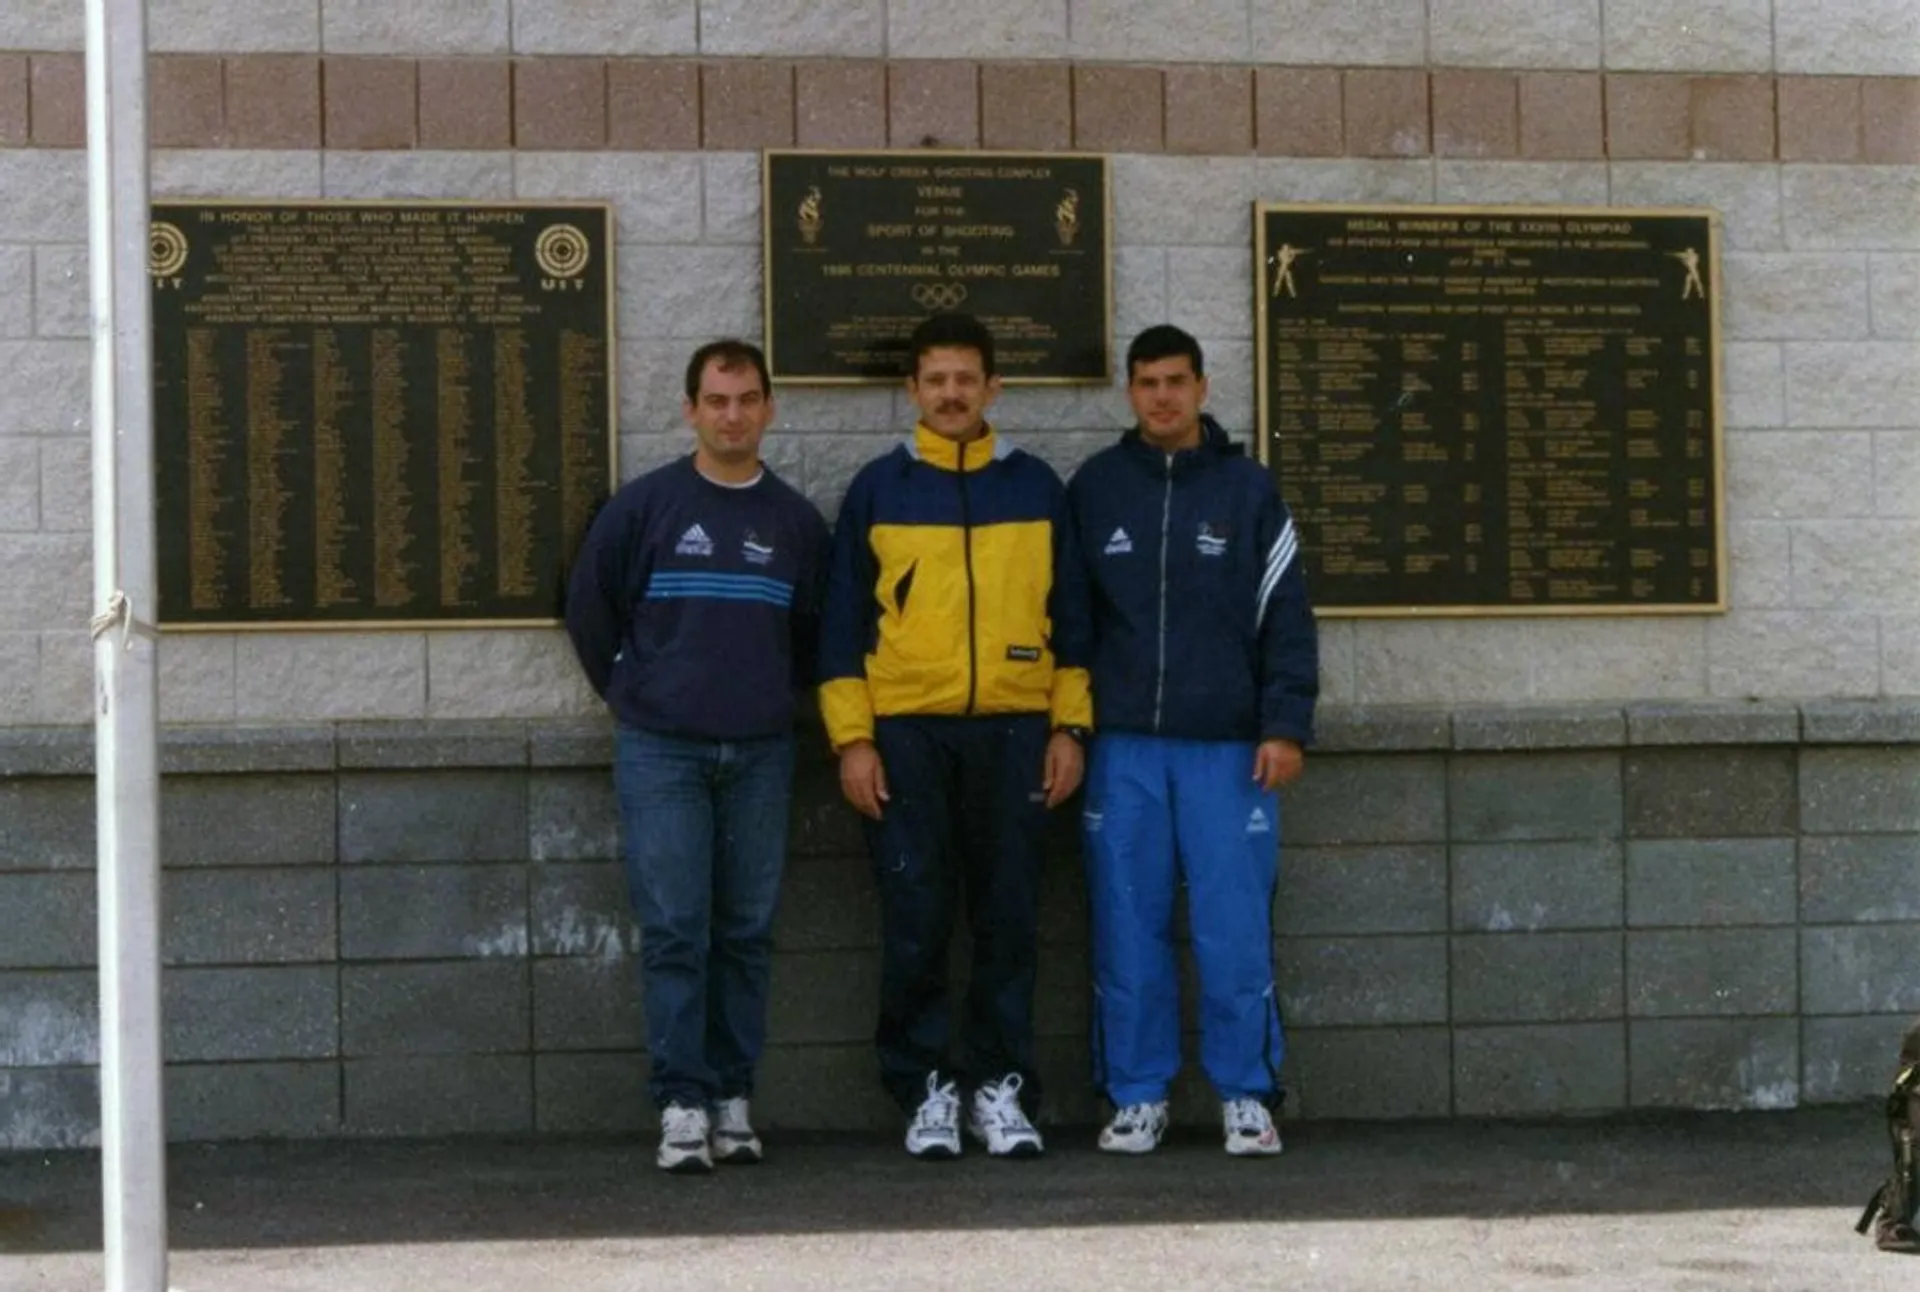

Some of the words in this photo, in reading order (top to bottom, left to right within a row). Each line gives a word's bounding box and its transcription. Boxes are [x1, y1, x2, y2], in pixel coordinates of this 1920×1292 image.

[827, 165, 850, 178] THE
[854, 165, 886, 178] WOLF
[890, 166, 929, 178] CREEK
[933, 166, 993, 178] SHOOTING
[997, 166, 1052, 179] COMPLEX
[916, 184, 964, 199] VENUE
[221, 211, 274, 223] HONOR
[279, 211, 299, 223] OF
[306, 211, 352, 223] THOSE
[359, 211, 395, 223] WHO
[400, 211, 439, 223] MADE
[446, 212, 460, 223] IT
[466, 212, 526, 224] HAPPEN
[914, 205, 940, 217] FOR
[943, 205, 966, 217] THE
[866, 223, 914, 238] SPORT
[917, 223, 939, 238] OF
[942, 224, 1016, 239] SHOOTING
[1347, 219, 1390, 233] MEDAL
[1396, 219, 1459, 233] WINNERS
[1463, 220, 1483, 233] OF
[1488, 221, 1513, 234] THE
[1565, 221, 1632, 235] OLYMPIAD
[938, 245, 962, 257] THE
[856, 263, 942, 277] CENTENNIAL
[948, 263, 1007, 278] OLYMPIC
[1012, 264, 1061, 278] GAMES
